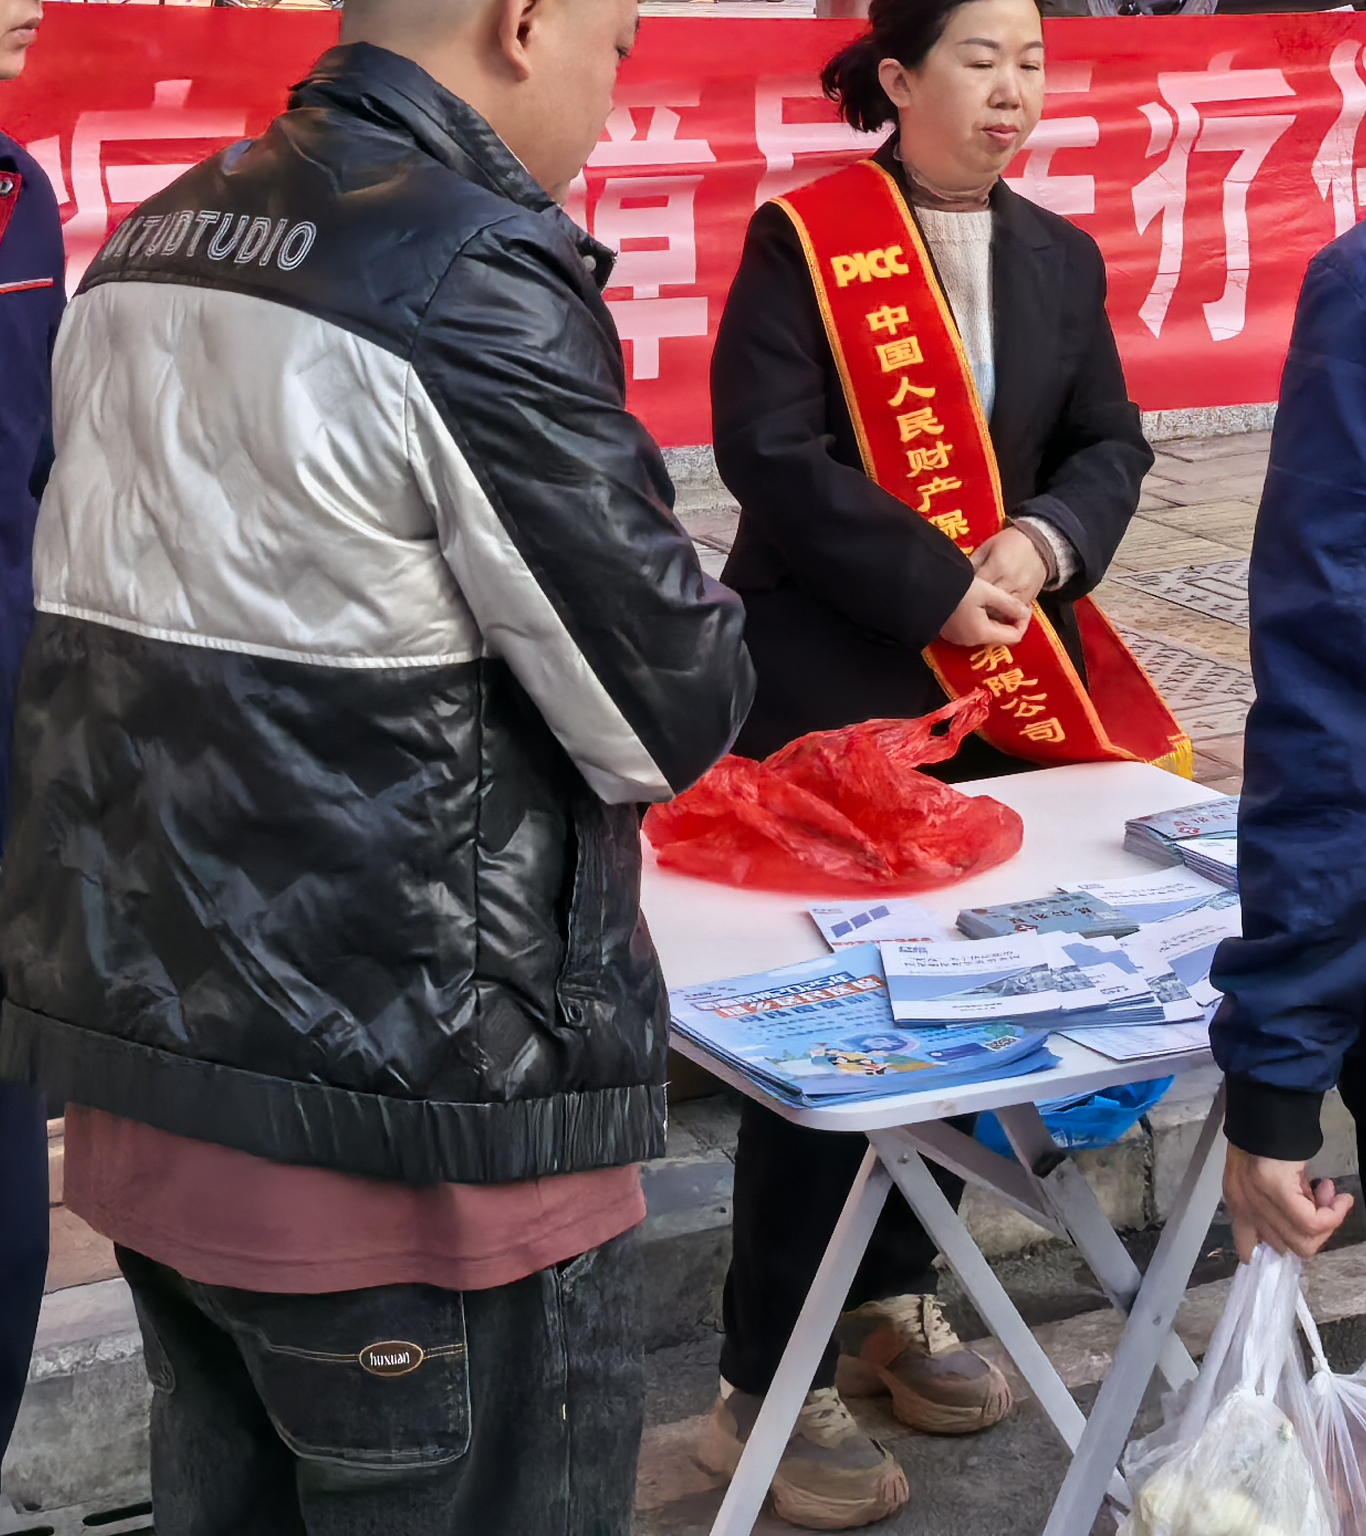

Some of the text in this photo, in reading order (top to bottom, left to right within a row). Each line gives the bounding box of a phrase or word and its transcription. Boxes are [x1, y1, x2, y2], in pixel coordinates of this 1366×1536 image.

[830, 245, 909, 288] PICC
[865, 304, 1066, 744] 中国人民财产保有限公司
